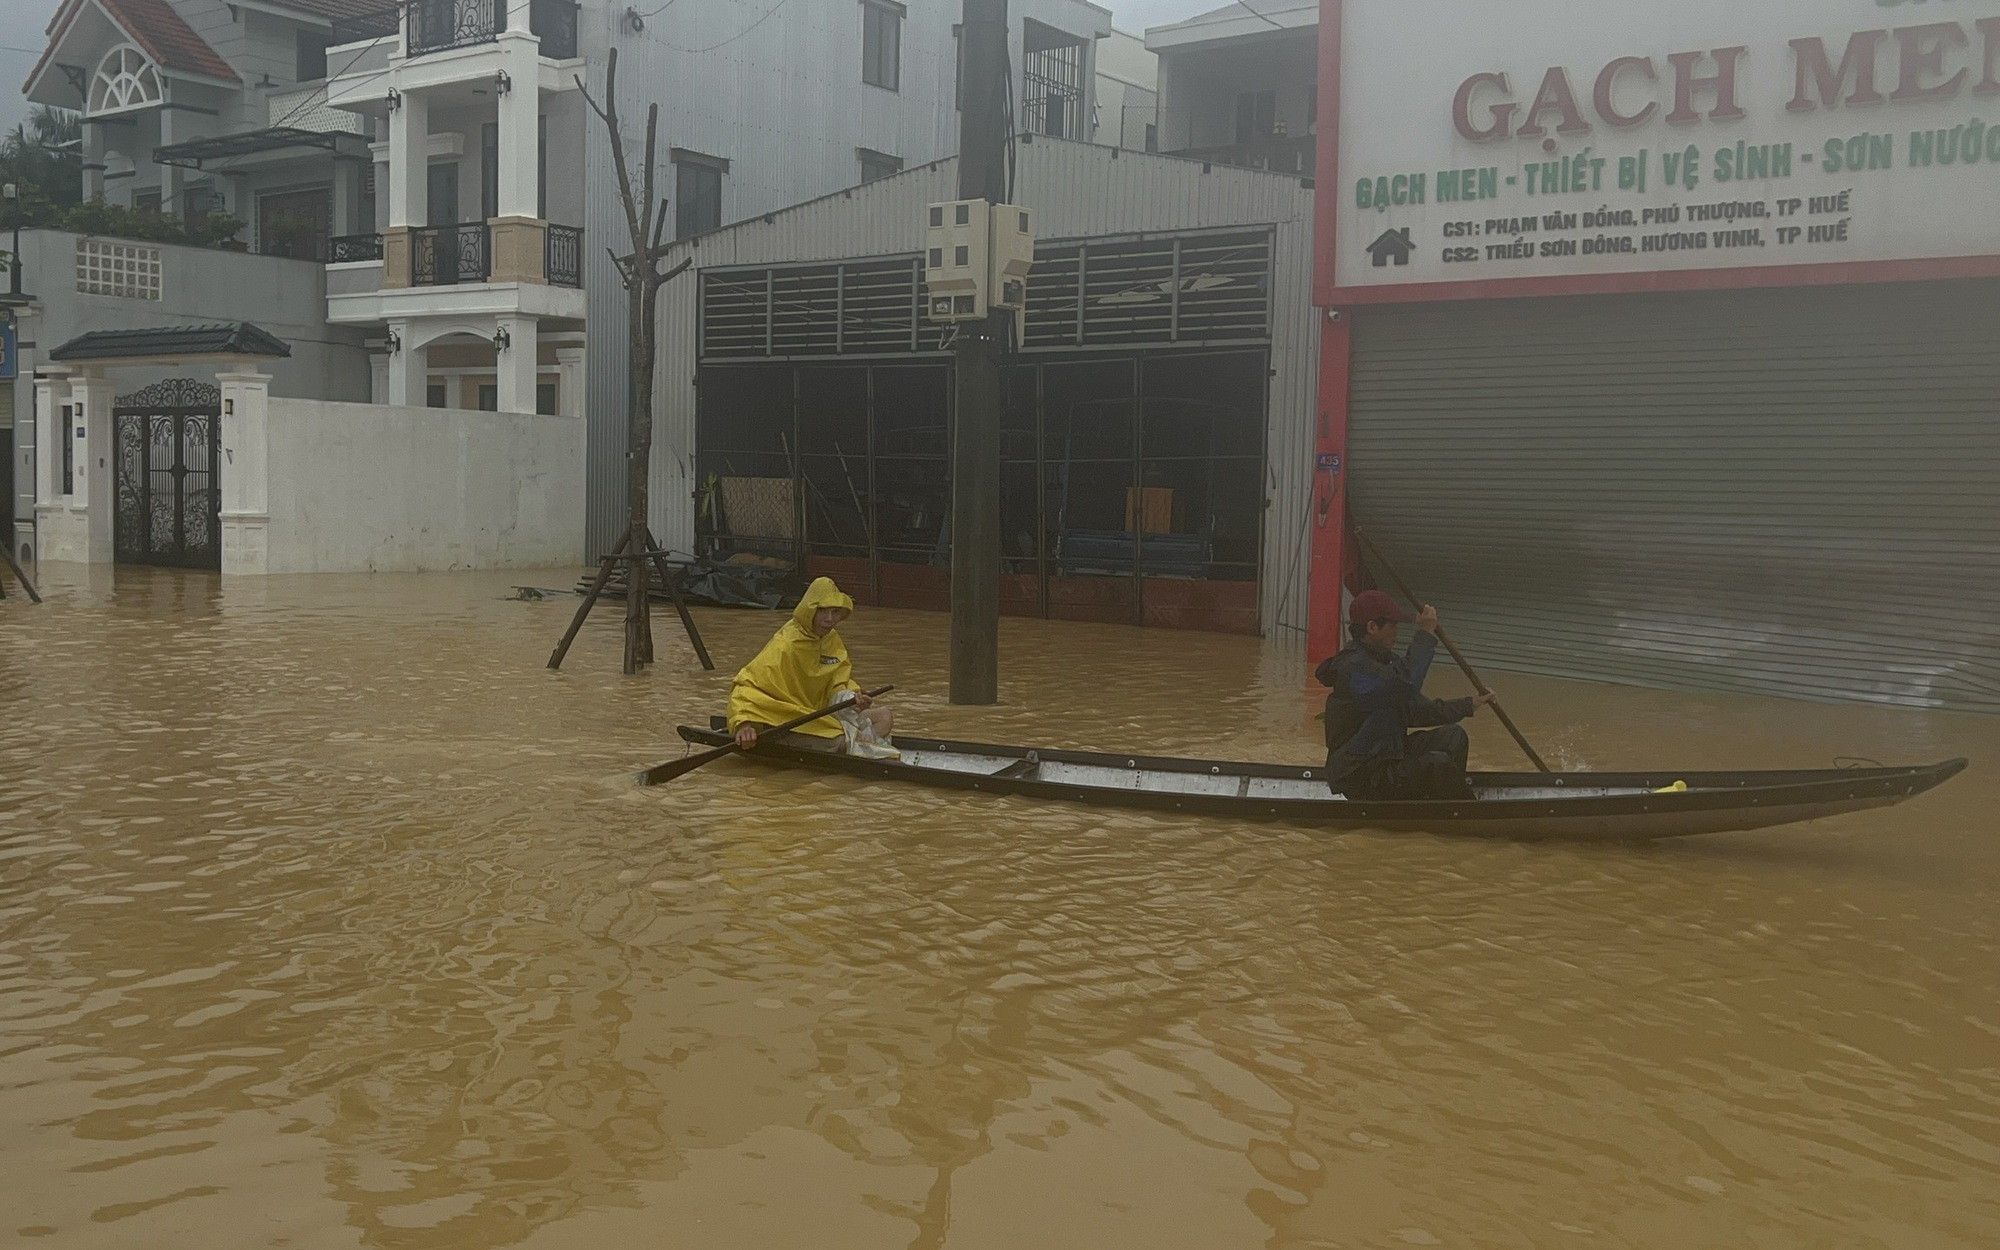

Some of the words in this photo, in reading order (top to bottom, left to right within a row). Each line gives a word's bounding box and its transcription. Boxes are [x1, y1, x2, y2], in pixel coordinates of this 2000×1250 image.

[1453, 45, 1749, 151] GẠCH
[1788, 16, 2000, 112] ME
[1356, 172, 1426, 213] GẠCH
[1436, 166, 1498, 203] MEN
[1524, 146, 1606, 196] THIẾT
[1618, 148, 1648, 193] BỊ
[1663, 144, 1701, 191] VỆ
[1822, 131, 1894, 174] SƠN
[1443, 221, 1480, 237] CS1:
[1485, 216, 1538, 236] PHẠM
[1542, 210, 1577, 231] VĂN
[1642, 203, 1680, 224] PHÚ
[1686, 201, 1771, 224] THƯỢNG,
[1777, 198, 1802, 216] TP
[1808, 188, 1852, 215] HUẾ
[1442, 246, 1479, 263] CS2:
[1540, 238, 1577, 257] SƠN
[1582, 234, 1637, 255] ĐÔNG,
[1641, 232, 1708, 252] HƯƠNG
[1713, 228, 1766, 249] VINH,
[1776, 226, 1801, 244] TP
[1807, 216, 1852, 243] HUẾ
[1320, 455, 1339, 466] 435
